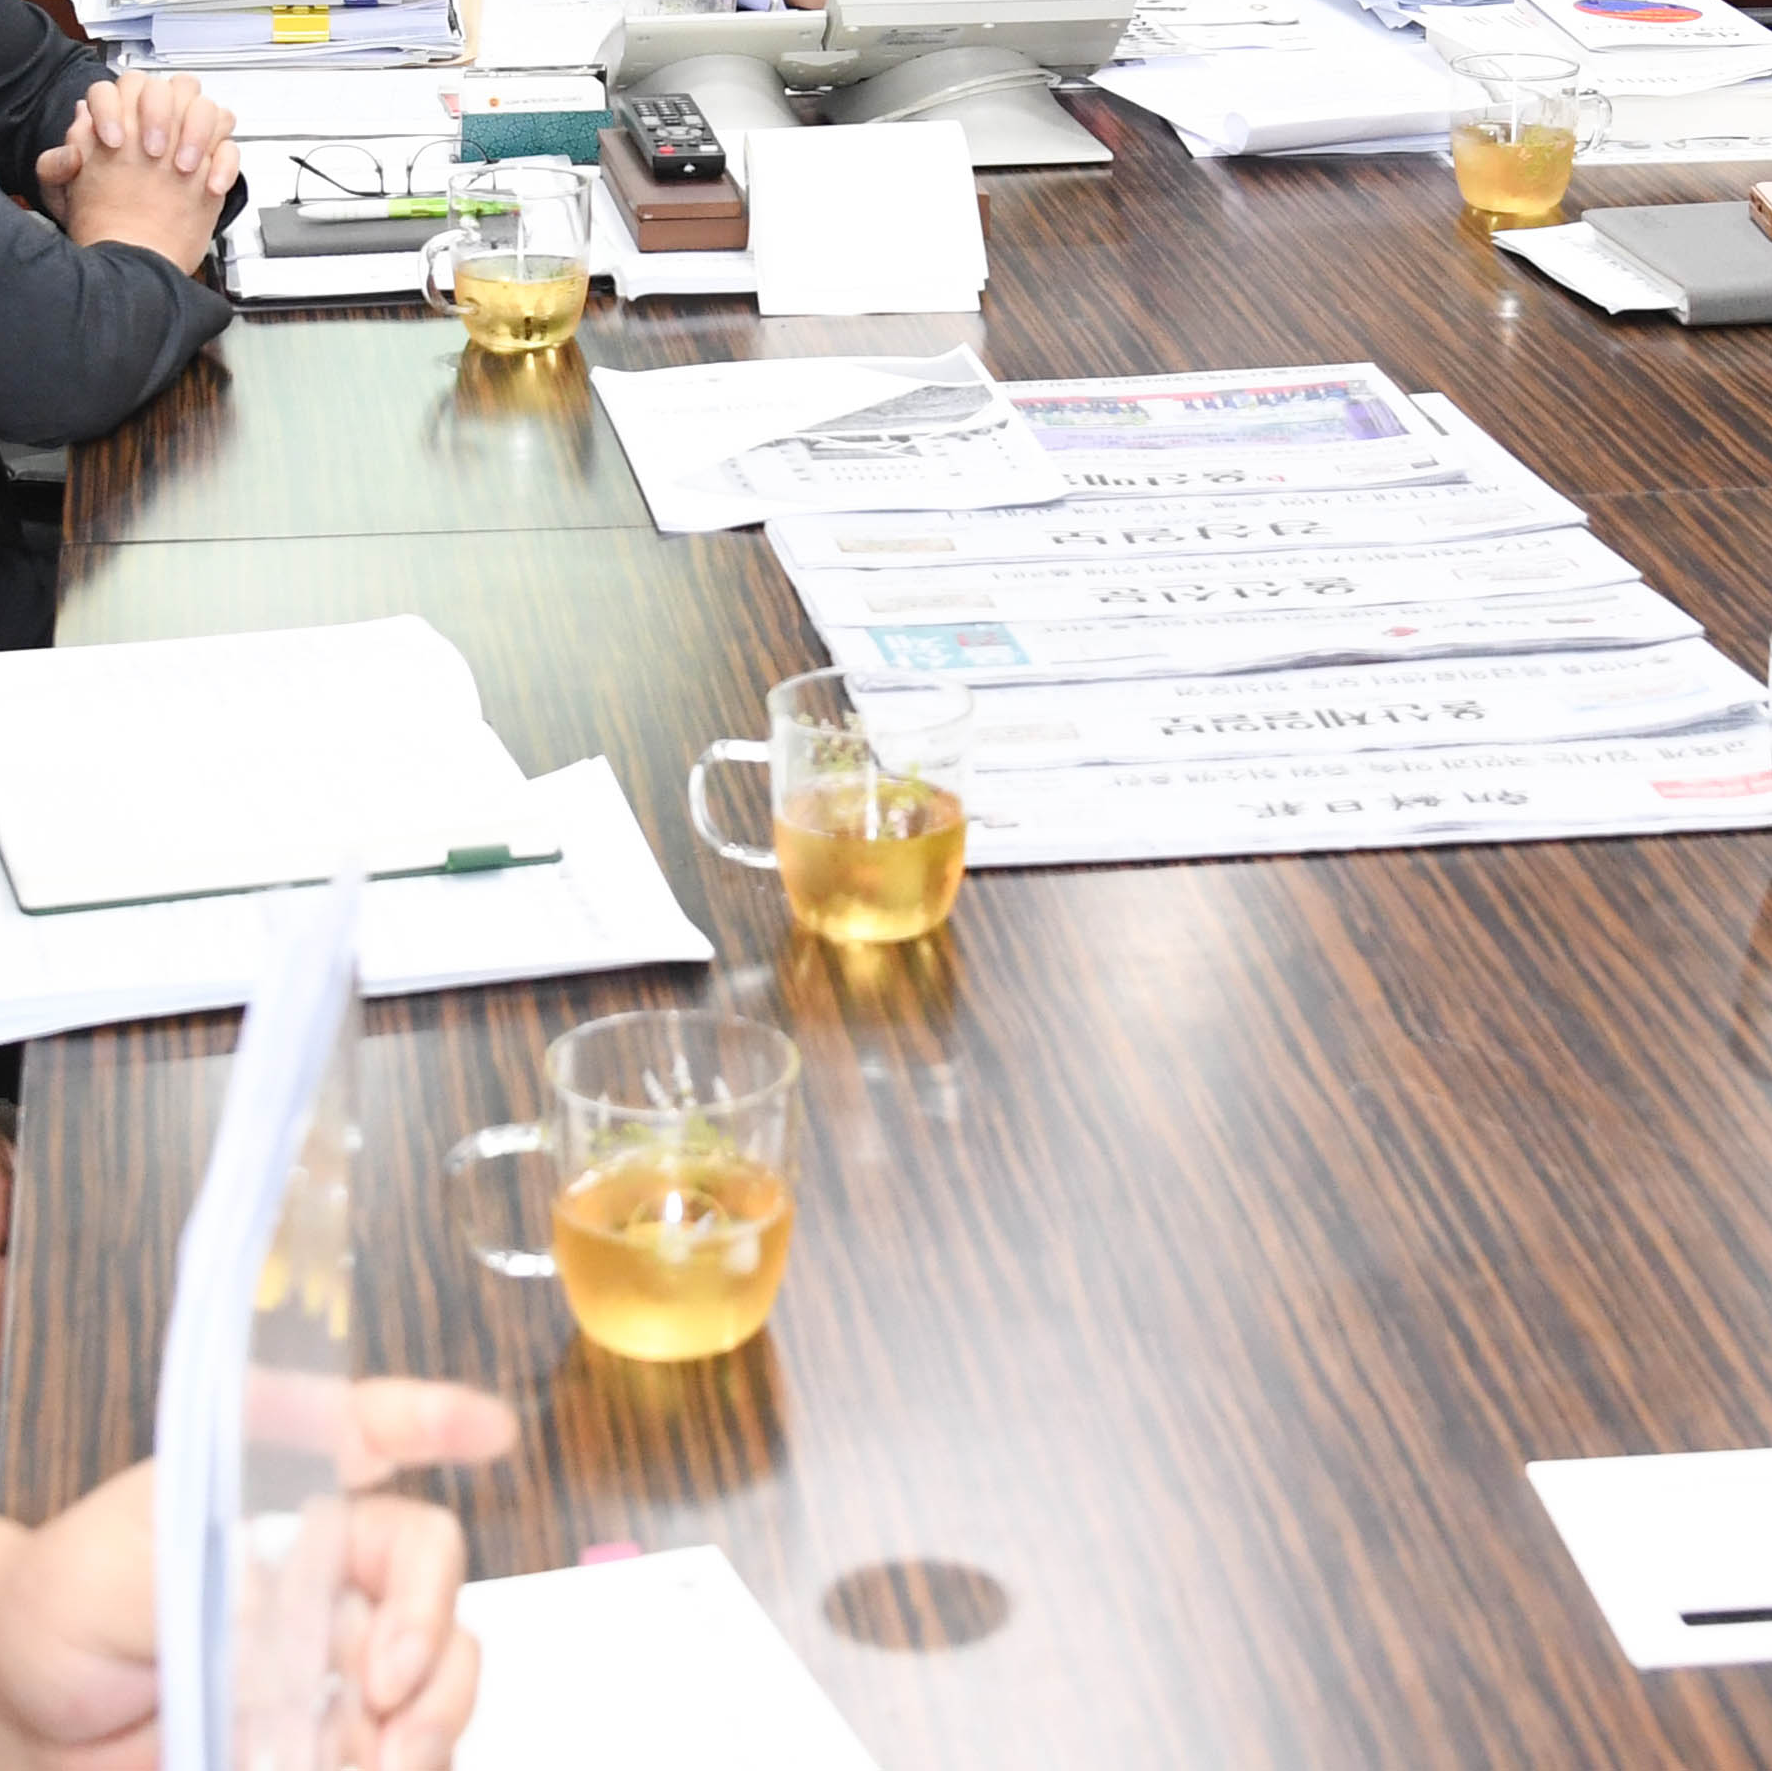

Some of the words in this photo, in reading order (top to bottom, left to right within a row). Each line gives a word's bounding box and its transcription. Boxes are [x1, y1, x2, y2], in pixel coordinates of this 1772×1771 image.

[1045, 519, 1334, 549] 경상일보
[1087, 574, 1360, 607] 울산신문
[1151, 699, 1489, 738] 울산제일일보
